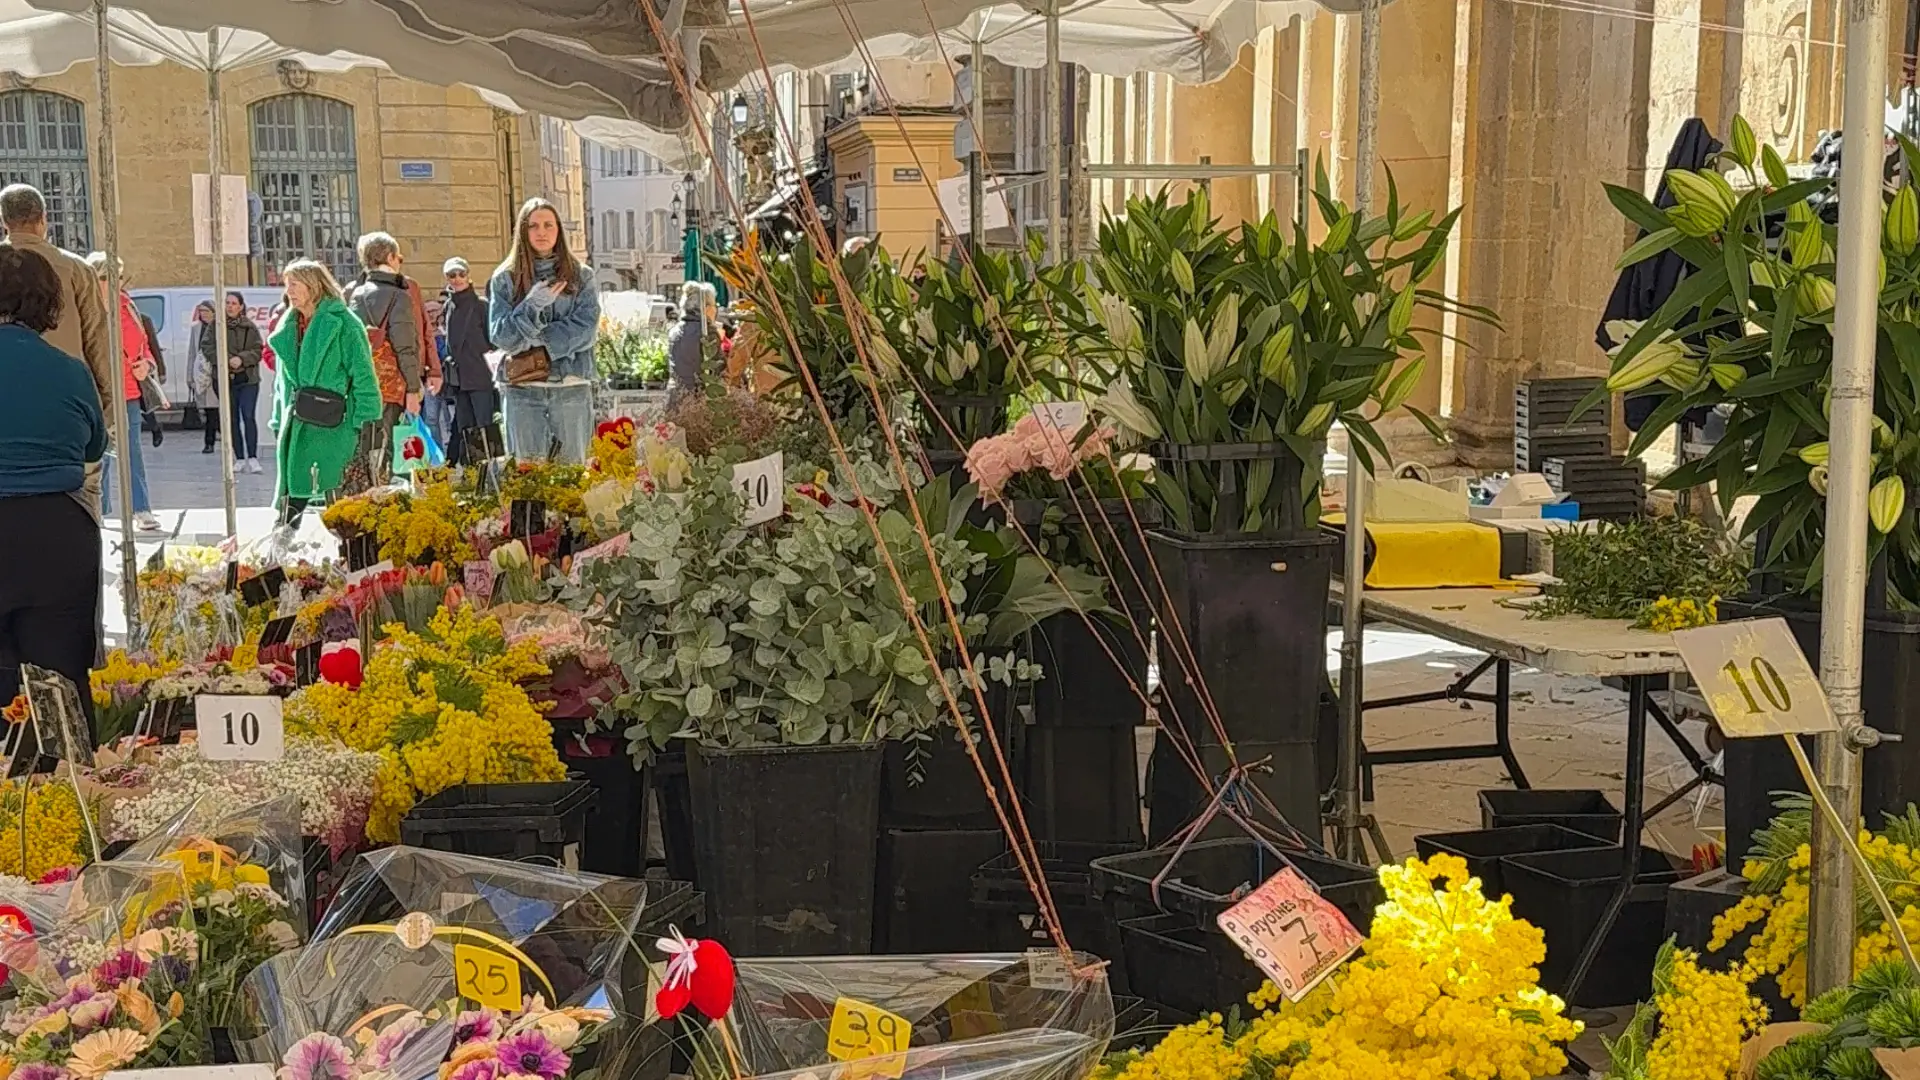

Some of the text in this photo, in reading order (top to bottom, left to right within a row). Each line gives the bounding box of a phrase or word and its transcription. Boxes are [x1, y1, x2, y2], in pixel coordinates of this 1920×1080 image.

[1722, 656, 1792, 714] 10
[221, 711, 260, 746] 10
[464, 958, 509, 996] 25
[834, 1010, 897, 1061] 39
